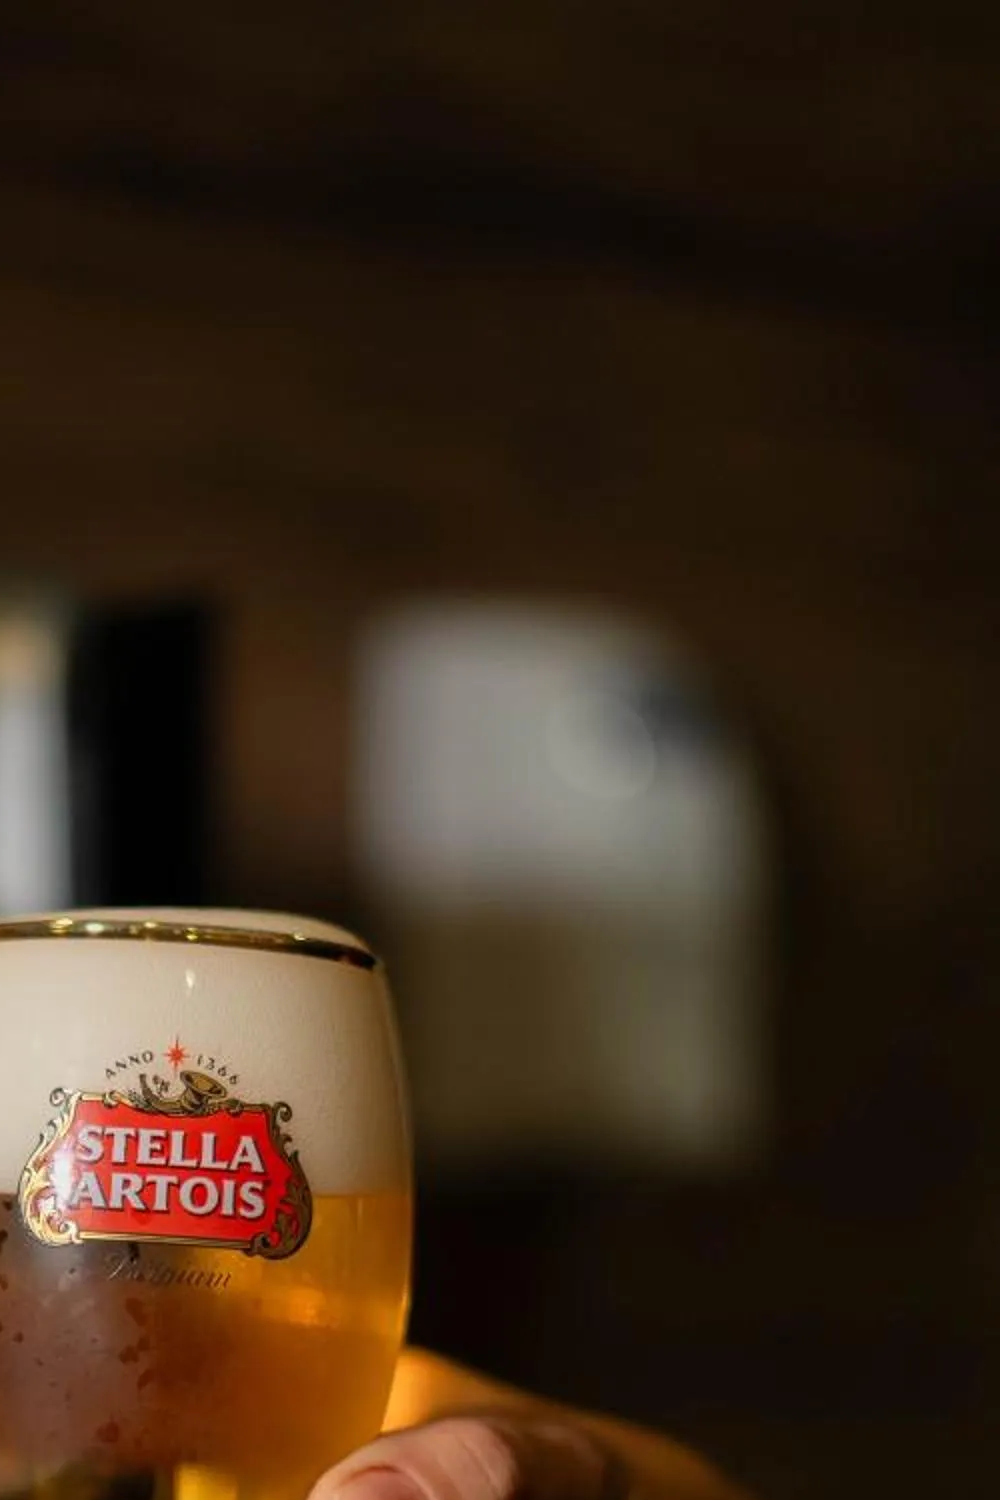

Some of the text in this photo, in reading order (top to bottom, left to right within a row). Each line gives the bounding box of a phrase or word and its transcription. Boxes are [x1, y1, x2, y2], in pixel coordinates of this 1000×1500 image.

[104, 1050, 240, 1086] ANNO 1366
[77, 1124, 265, 1173] STELLA
[70, 1173, 265, 1220] ARTOIS
